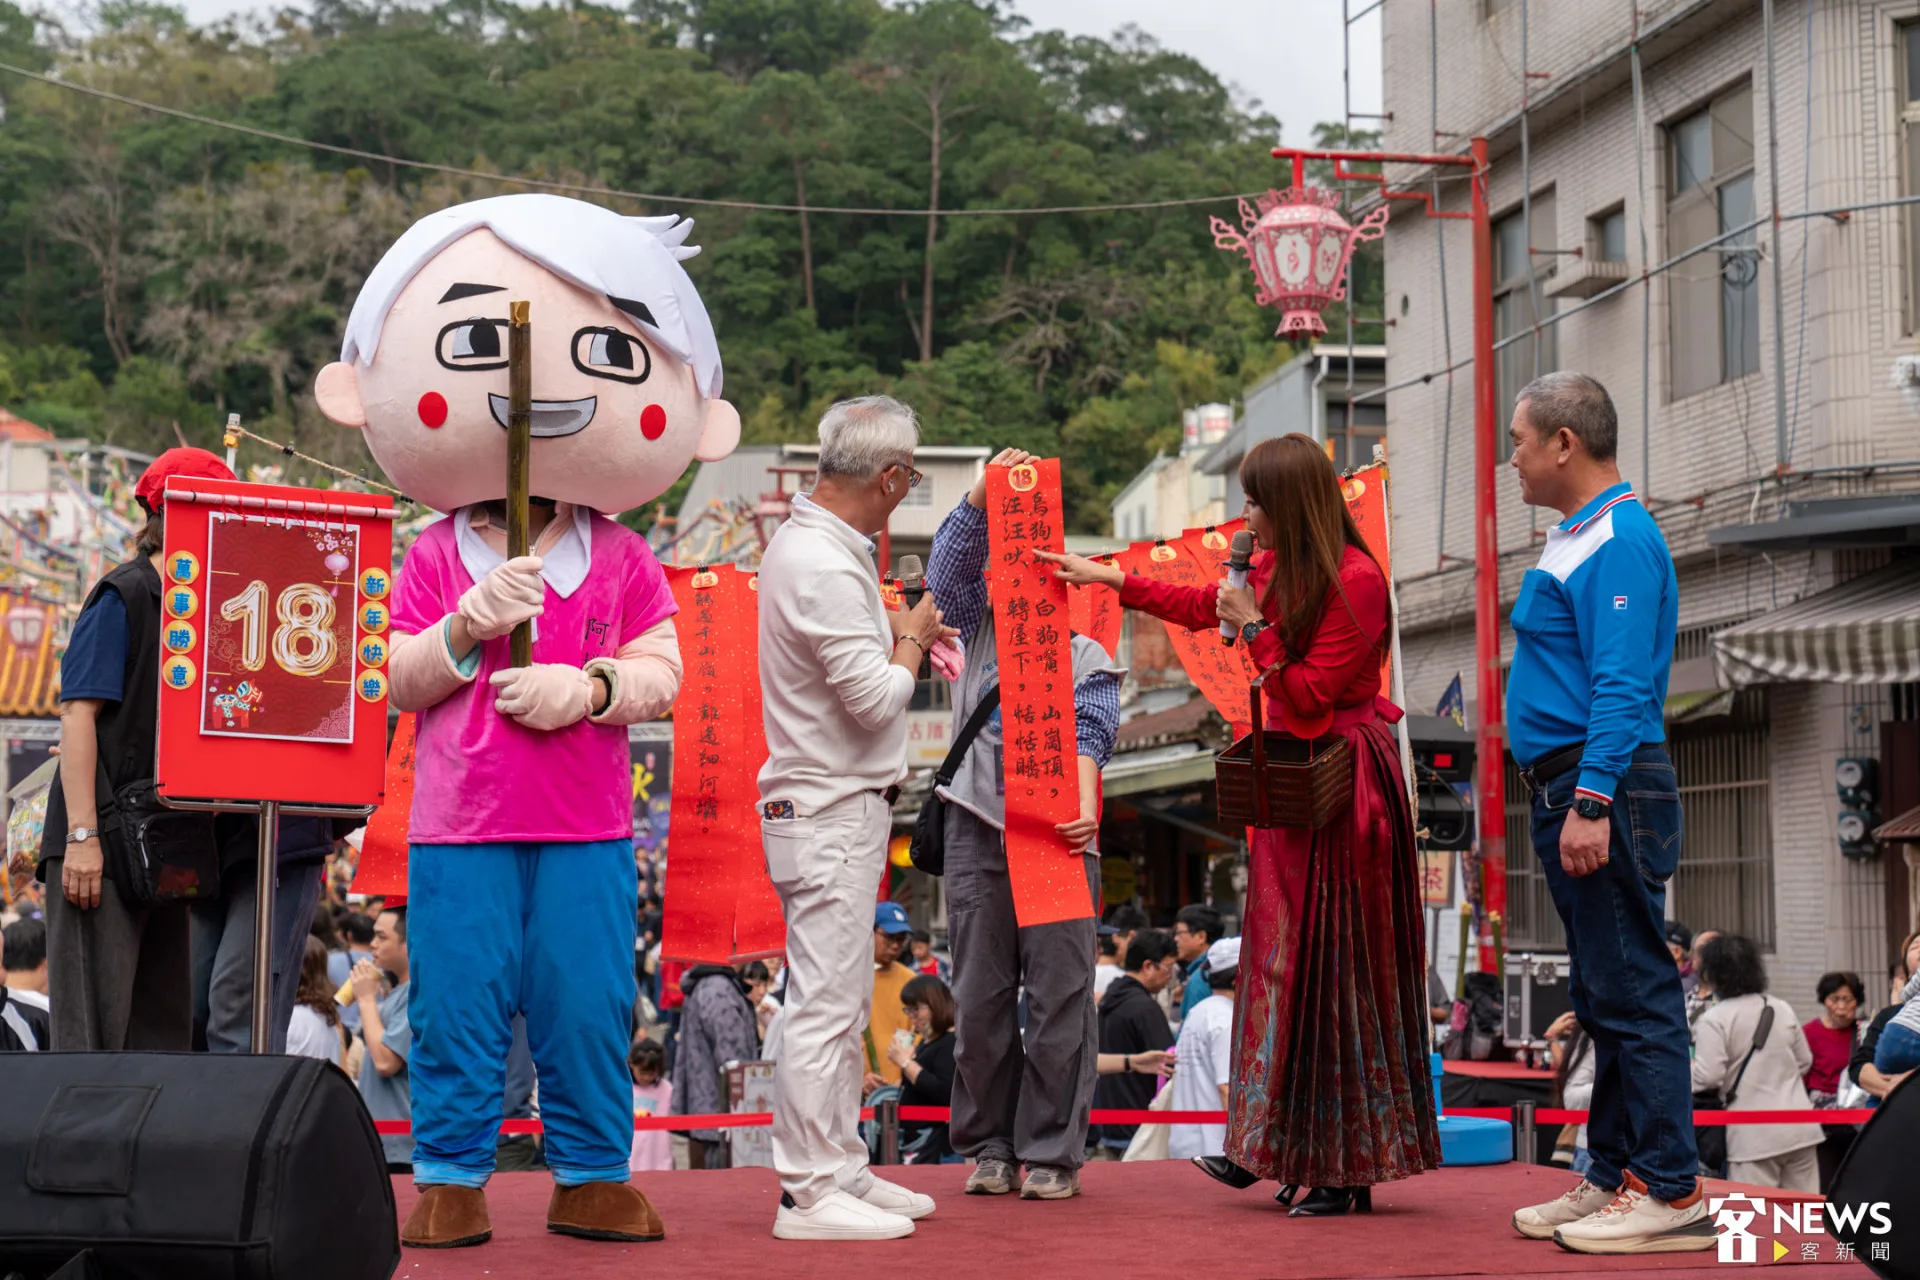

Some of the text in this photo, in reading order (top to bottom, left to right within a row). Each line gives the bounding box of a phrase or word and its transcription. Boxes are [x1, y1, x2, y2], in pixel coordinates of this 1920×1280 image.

[1012, 469, 1032, 486] 18
[1156, 548, 1169, 560] 5
[695, 576, 713, 586] 13
[881, 588, 897, 602] 10
[168, 558, 193, 686] 萬事勝意
[220, 579, 338, 676] 18
[362, 577, 386, 699] 新年快樂
